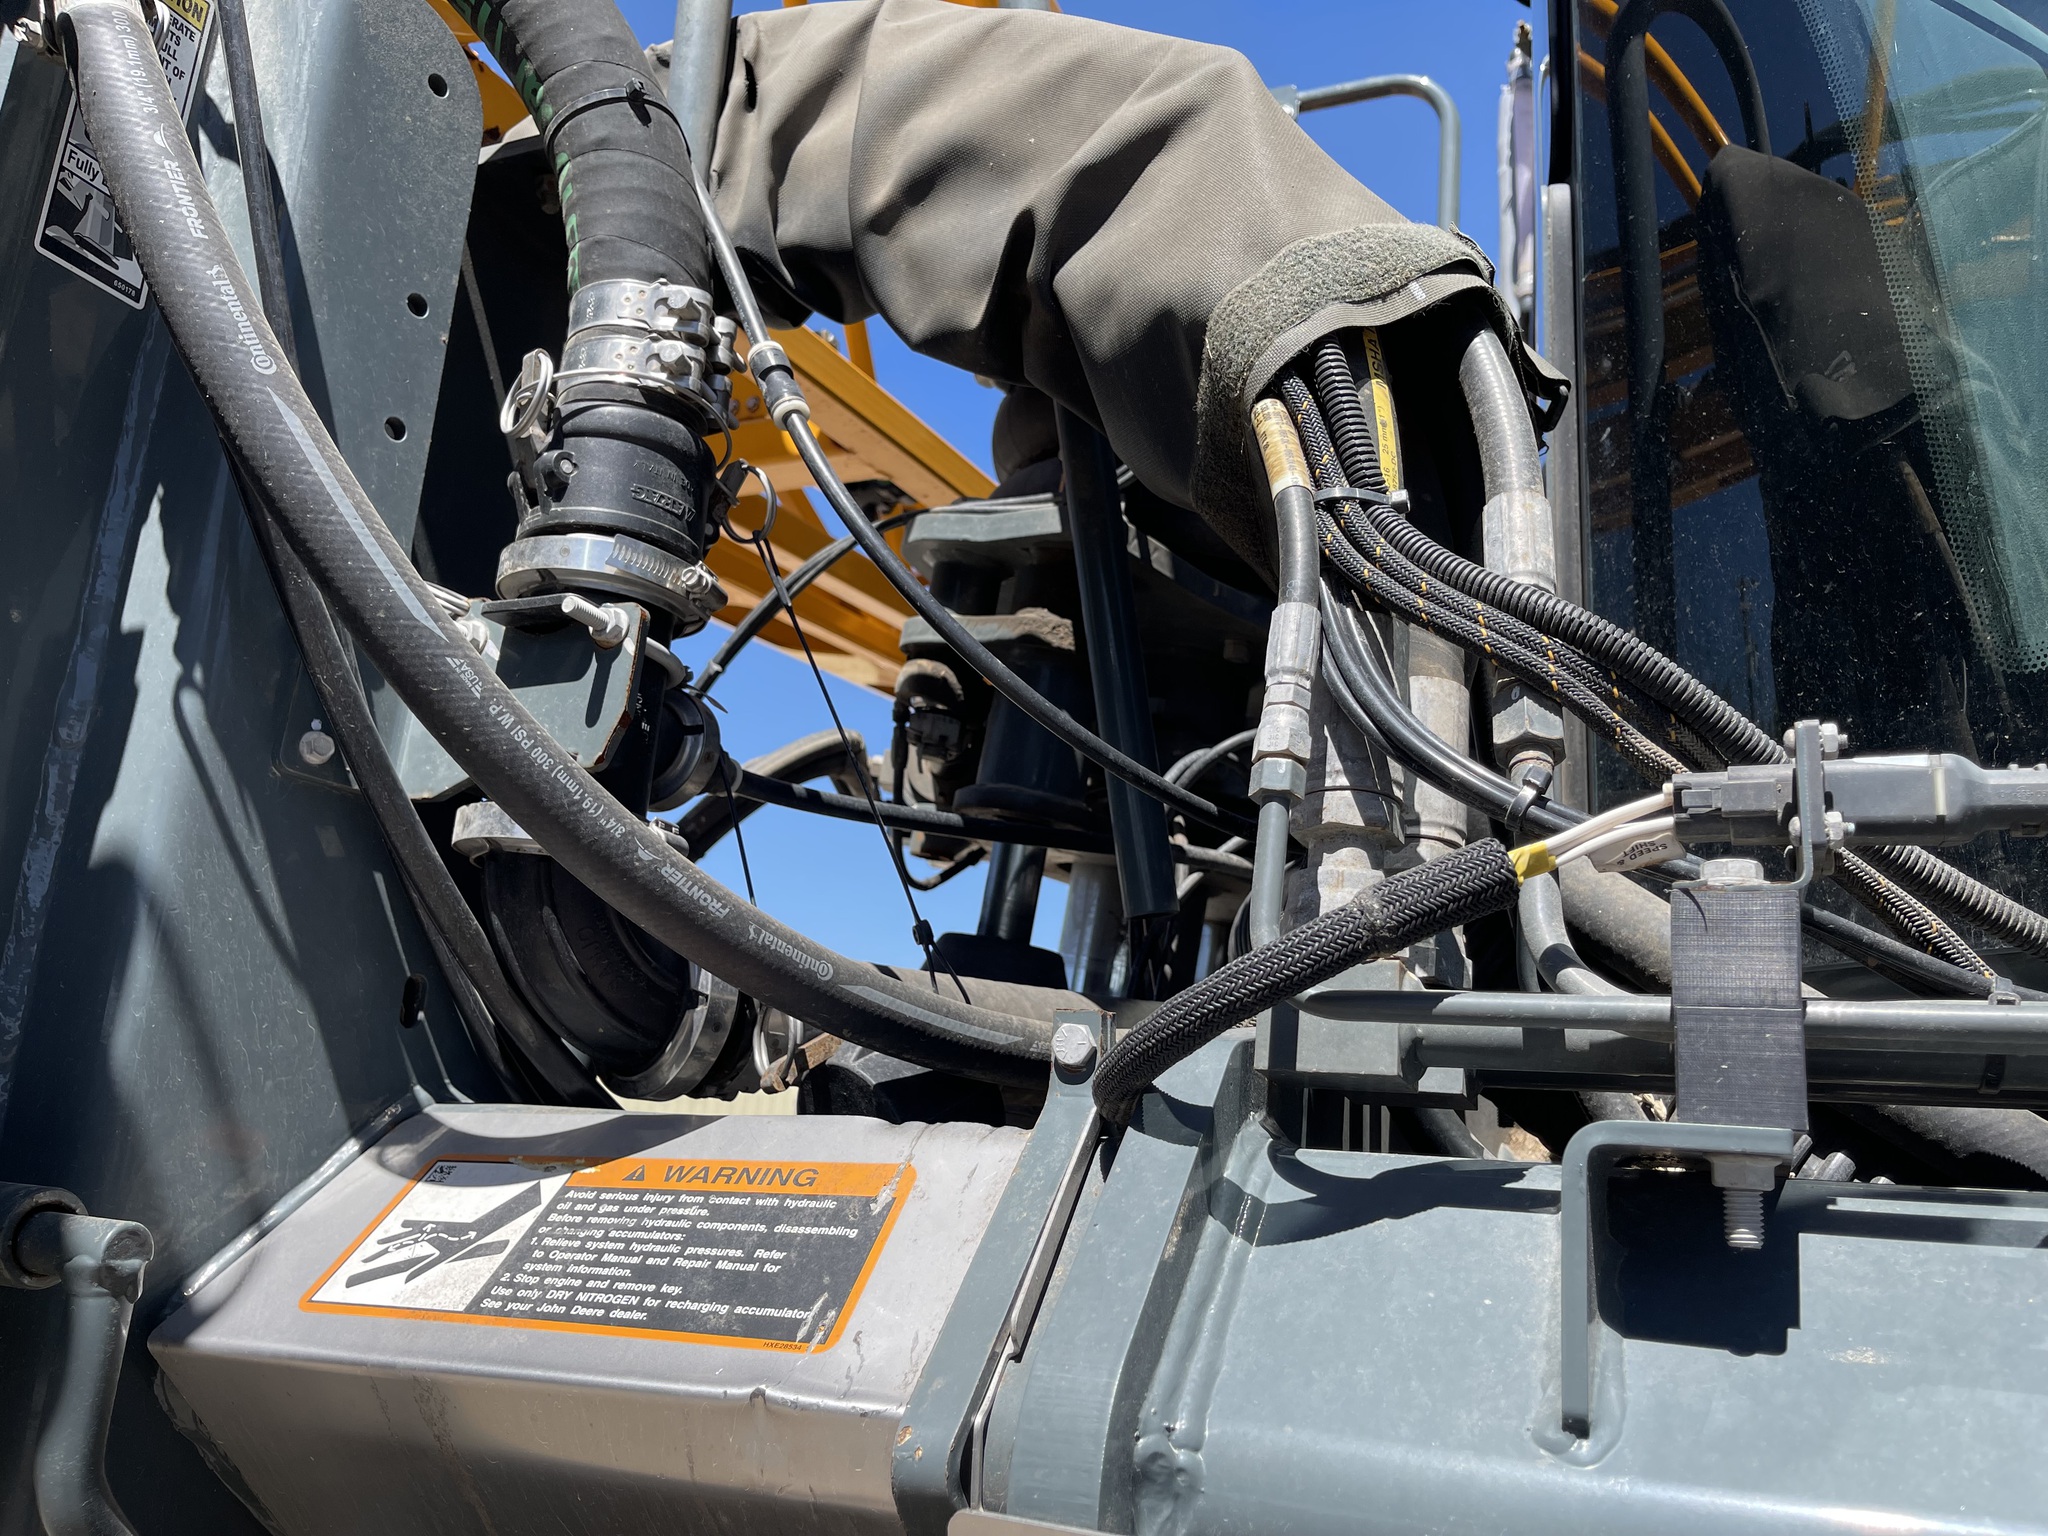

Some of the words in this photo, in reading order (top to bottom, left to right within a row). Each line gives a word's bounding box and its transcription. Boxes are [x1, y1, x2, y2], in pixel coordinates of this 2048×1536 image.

[111, 10, 132, 33] 300
[118, 35, 154, 88] (19.1mm)
[172, 66, 186, 80] OF
[137, 90, 159, 114] 3/4"
[67, 149, 99, 181] Fully
[163, 159, 209, 240] FRONTIER
[211, 278, 278, 375] Continental
[1367, 338, 1387, 390] MSHA
[1381, 443, 1390, 455] 25
[460, 662, 479, 685] USA
[488, 698, 515, 730] W.P.
[510, 725, 535, 750] PSI
[530, 746, 554, 770] 300
[551, 765, 604, 817] (19.1mm)
[598, 817, 626, 838] 3/4"
[1622, 840, 1656, 858] SHIFT
[1629, 843, 1668, 861] SPEED
[660, 865, 731, 919] FRONTIER
[758, 930, 834, 982] Continental
[664, 1165, 820, 1187] WARNING
[556, 1201, 572, 1210] oil
[574, 1203, 598, 1212] and
[599, 1204, 619, 1214] gas
[624, 1205, 656, 1214] under
[658, 1205, 710, 1217] pressure.
[564, 1190, 597, 1199] Avoid
[599, 1192, 639, 1201] serious
[642, 1192, 674, 1204] injury
[678, 1193, 705, 1203] from
[708, 1194, 751, 1205] contact
[755, 1197, 779, 1207] with
[783, 1198, 838, 1210] hydraulic
[538, 1226, 551, 1234] or
[554, 1226, 605, 1238] changing
[608, 1228, 686, 1241] accumulators:
[547, 1213, 583, 1223] Before
[586, 1216, 637, 1227] removing
[641, 1218, 692, 1229] hydraulic
[696, 1221, 768, 1233] components,
[773, 1223, 859, 1238] disassembling
[530, 1236, 538, 1246] 1.
[541, 1238, 582, 1248] Relieve
[584, 1240, 626, 1251] system
[629, 1241, 682, 1254] hydraulic
[684, 1246, 745, 1258] pressures.
[753, 1249, 787, 1260] Refer
[522, 1262, 562, 1272] system
[566, 1264, 632, 1277] information.
[531, 1249, 544, 1258] to
[548, 1250, 598, 1262] Operator
[601, 1253, 642, 1264] Manual
[645, 1256, 670, 1266] and
[672, 1257, 712, 1269] Repair
[715, 1260, 759, 1272] Manual
[762, 1263, 782, 1273] for
[500, 1272, 511, 1282] 2.
[513, 1273, 540, 1284] Stop
[543, 1277, 583, 1288] engine
[586, 1278, 610, 1288] and
[613, 1282, 656, 1292] remove
[660, 1283, 683, 1296] key.
[480, 1298, 502, 1309] See
[504, 1302, 534, 1312] your
[536, 1303, 566, 1314] John
[570, 1305, 605, 1317] Deere
[609, 1307, 647, 1320] dealer.
[490, 1285, 513, 1296] Use
[516, 1288, 542, 1300] only
[545, 1290, 573, 1300] DRY
[575, 1292, 641, 1306] NITROGEN
[643, 1297, 661, 1307] for
[665, 1299, 730, 1314] recharging
